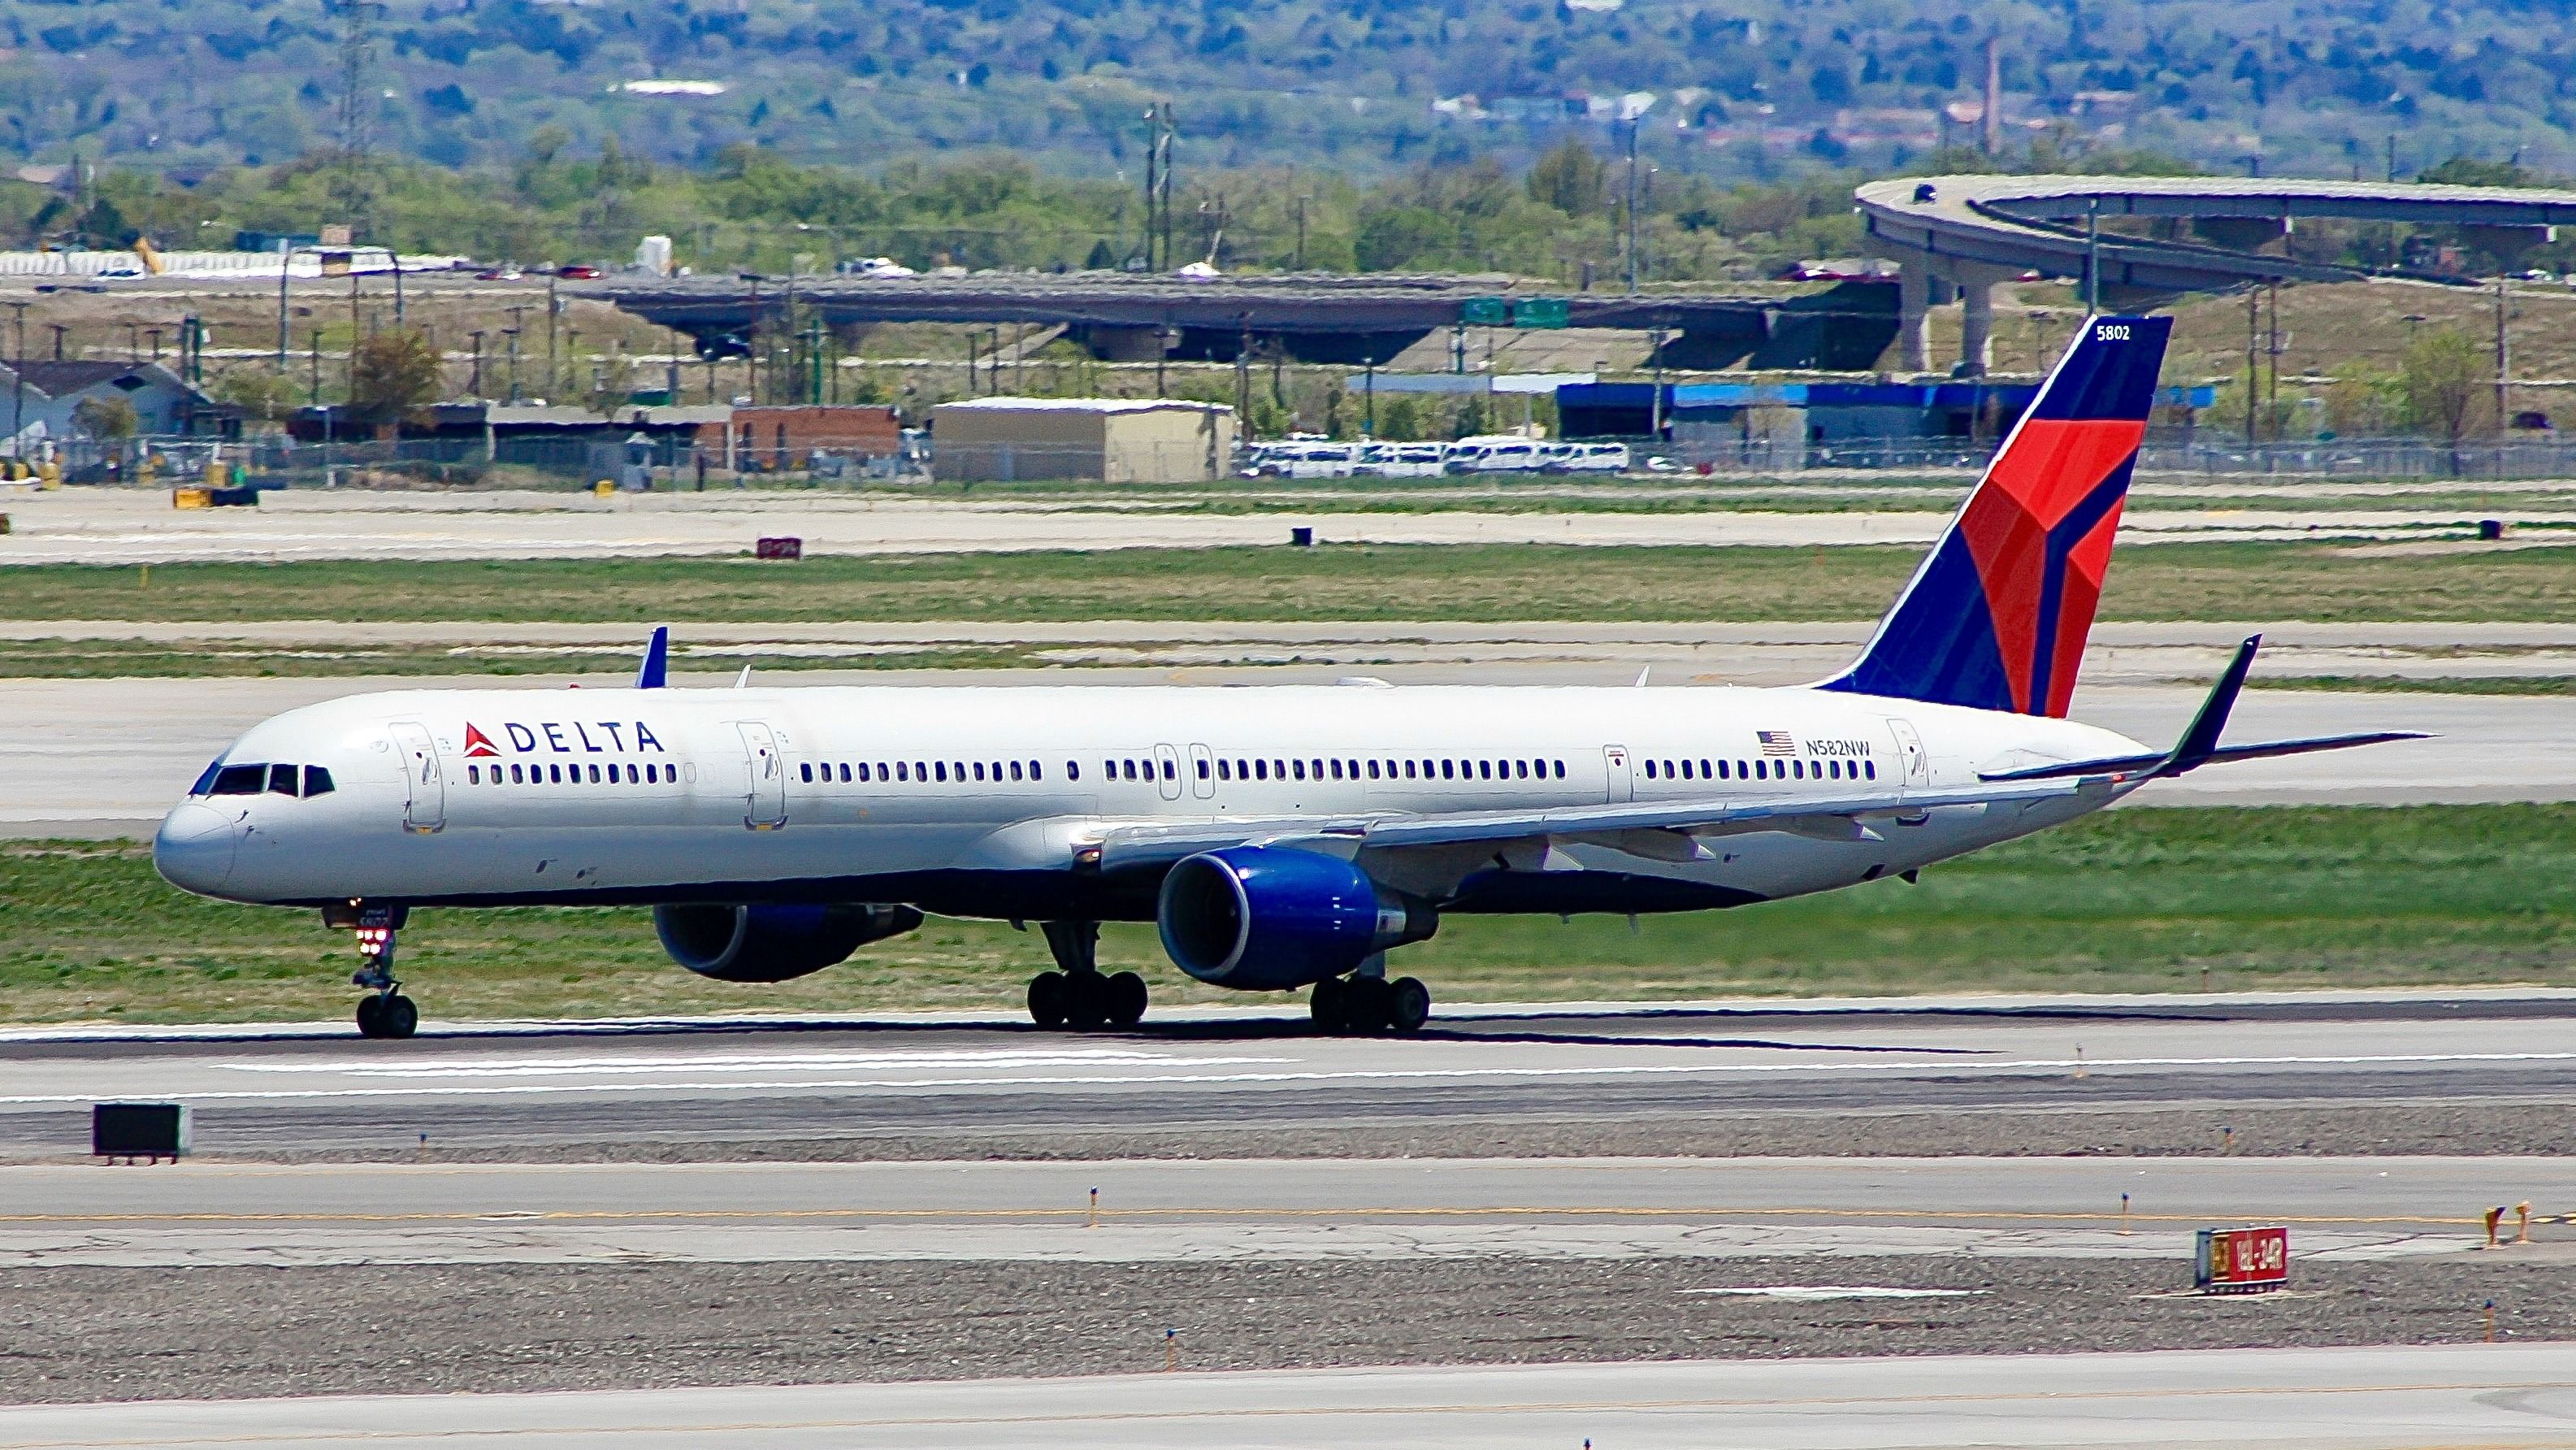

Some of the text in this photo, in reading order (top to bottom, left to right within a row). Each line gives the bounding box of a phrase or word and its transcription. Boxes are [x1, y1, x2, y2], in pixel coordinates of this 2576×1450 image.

[2097, 325, 2130, 341] 5802
[504, 721, 665, 753] DELTA
[1806, 740, 1870, 757] N582NW
